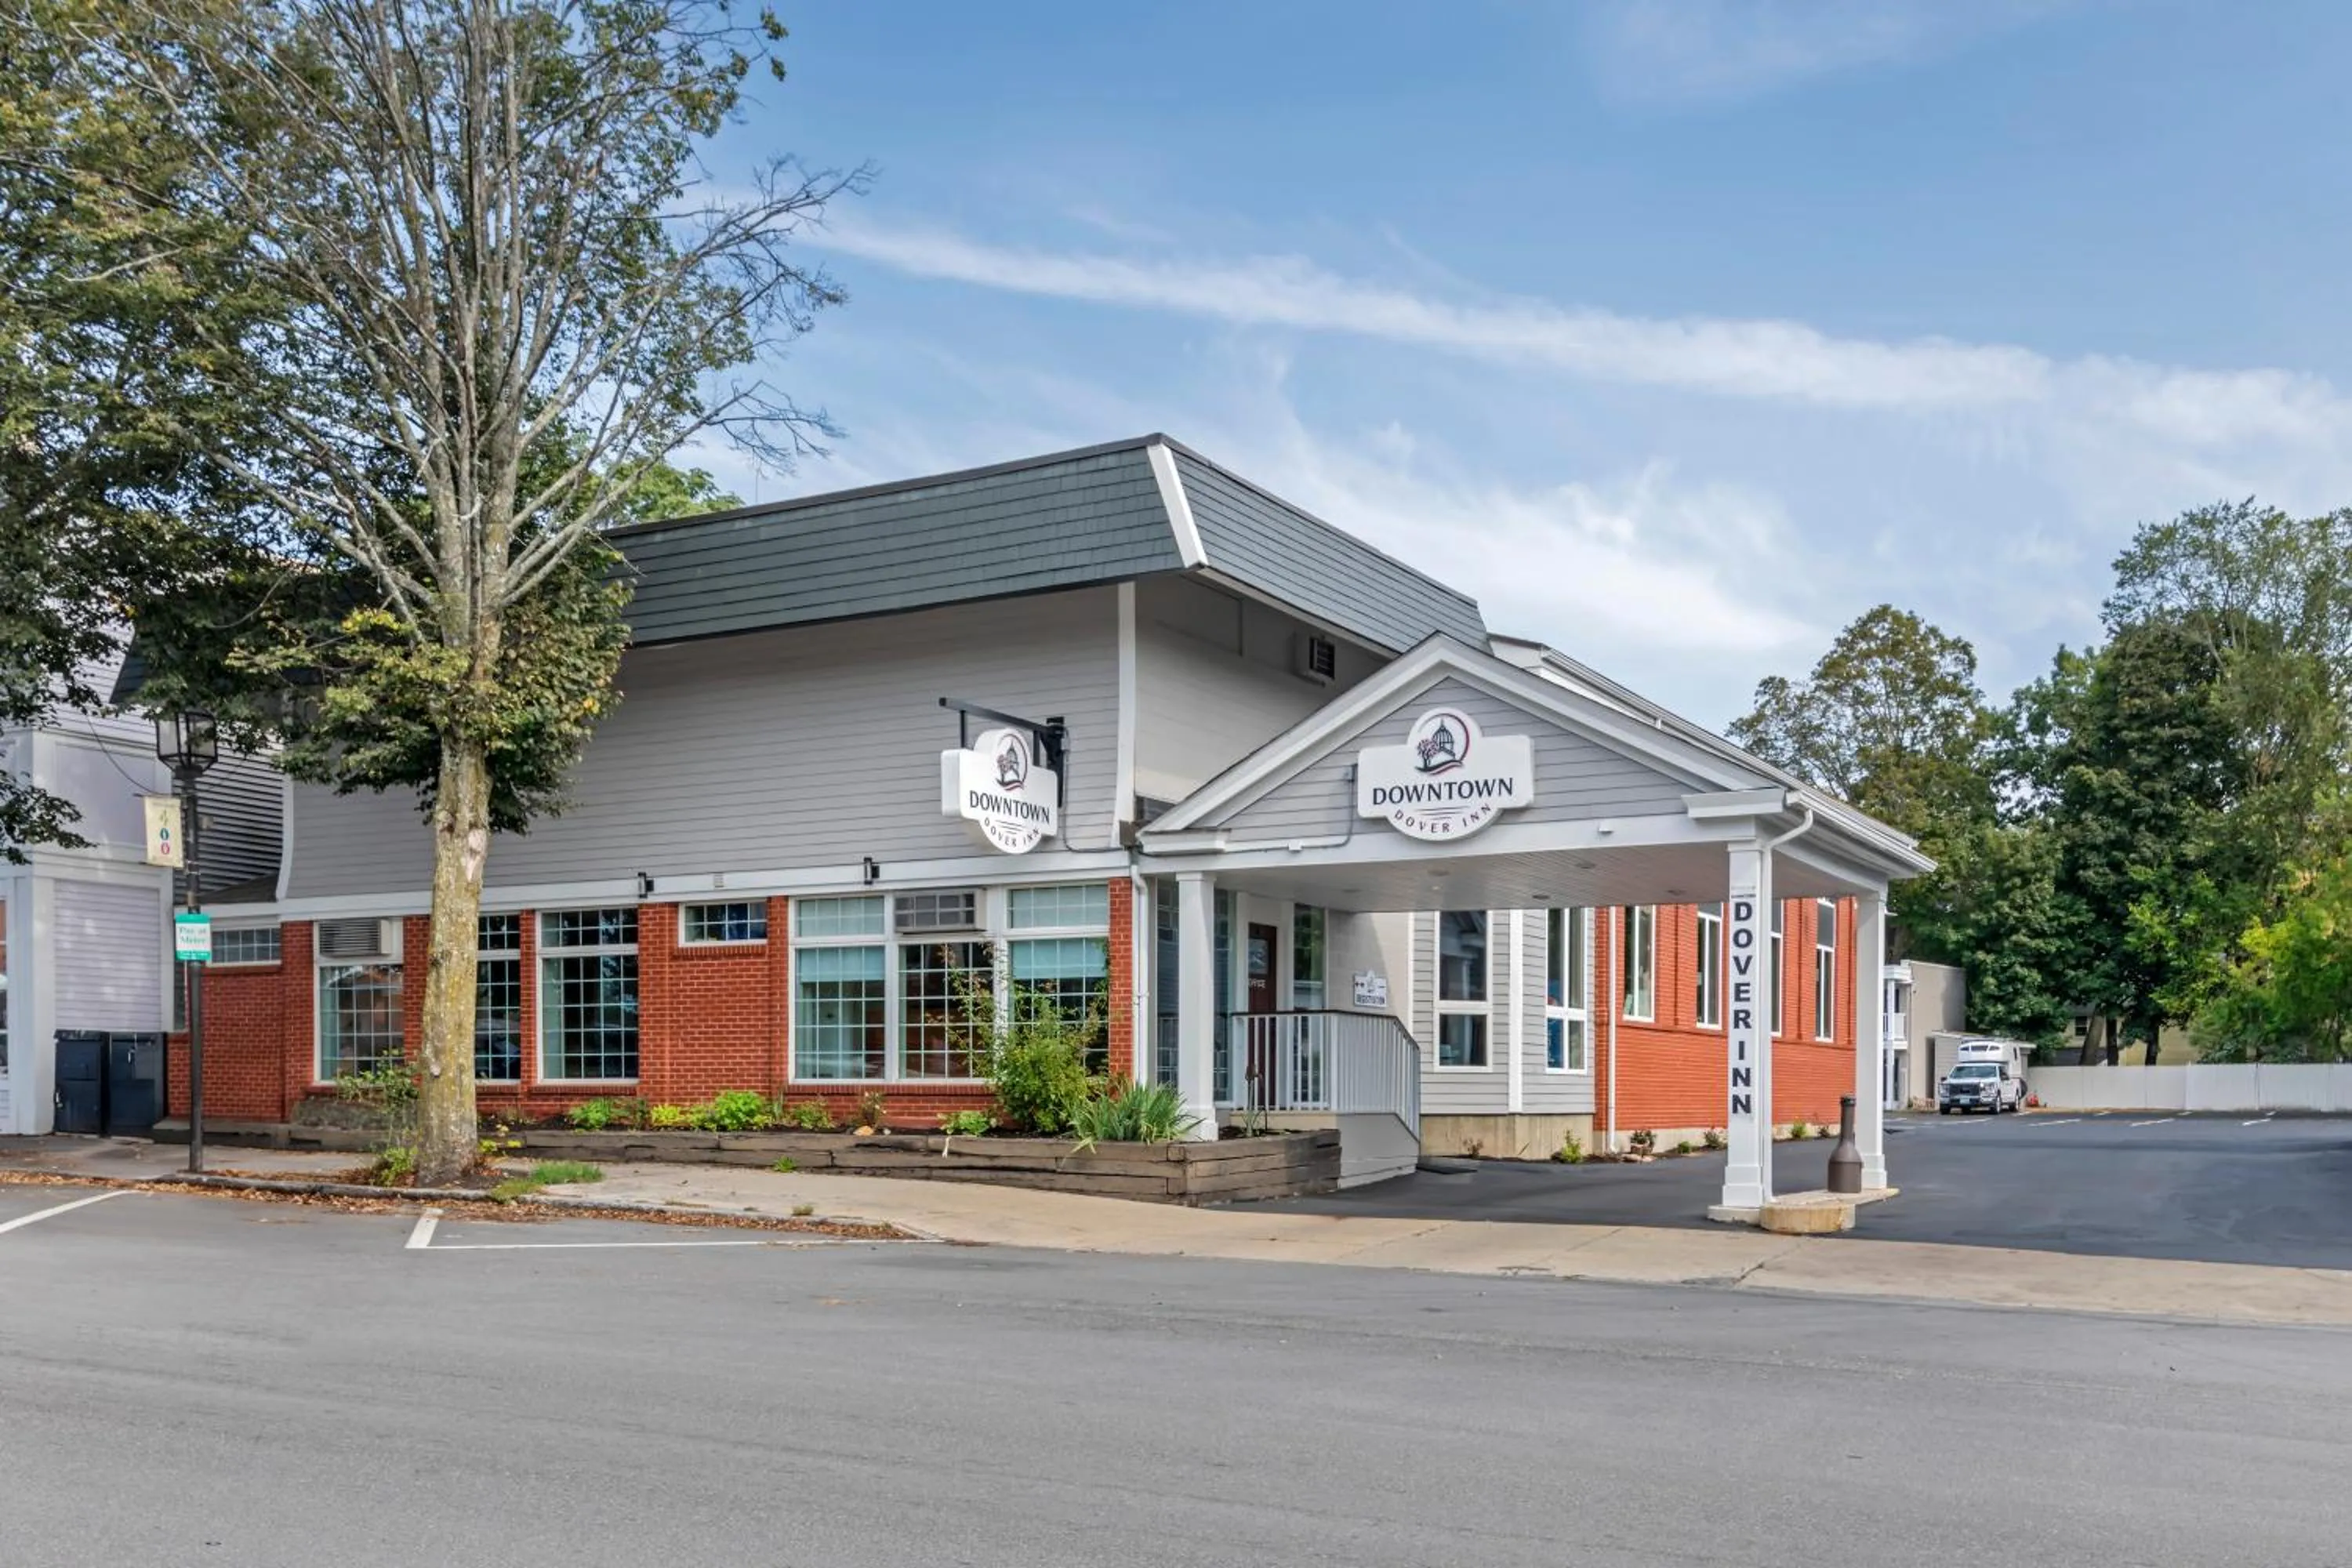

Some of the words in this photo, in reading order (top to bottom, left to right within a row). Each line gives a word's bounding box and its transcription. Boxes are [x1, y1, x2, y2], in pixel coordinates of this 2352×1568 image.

[969, 789, 1050, 824] DOWNTOWN
[1373, 777, 1513, 805] DOWNTOWN
[984, 817, 1017, 847] DOVER
[1022, 827, 1040, 845] INN
[1394, 809, 1450, 833] DOVER
[1462, 804, 1491, 827] INN
[1732, 901, 1753, 1029] DOVER
[1731, 1040, 1752, 1114] INN
